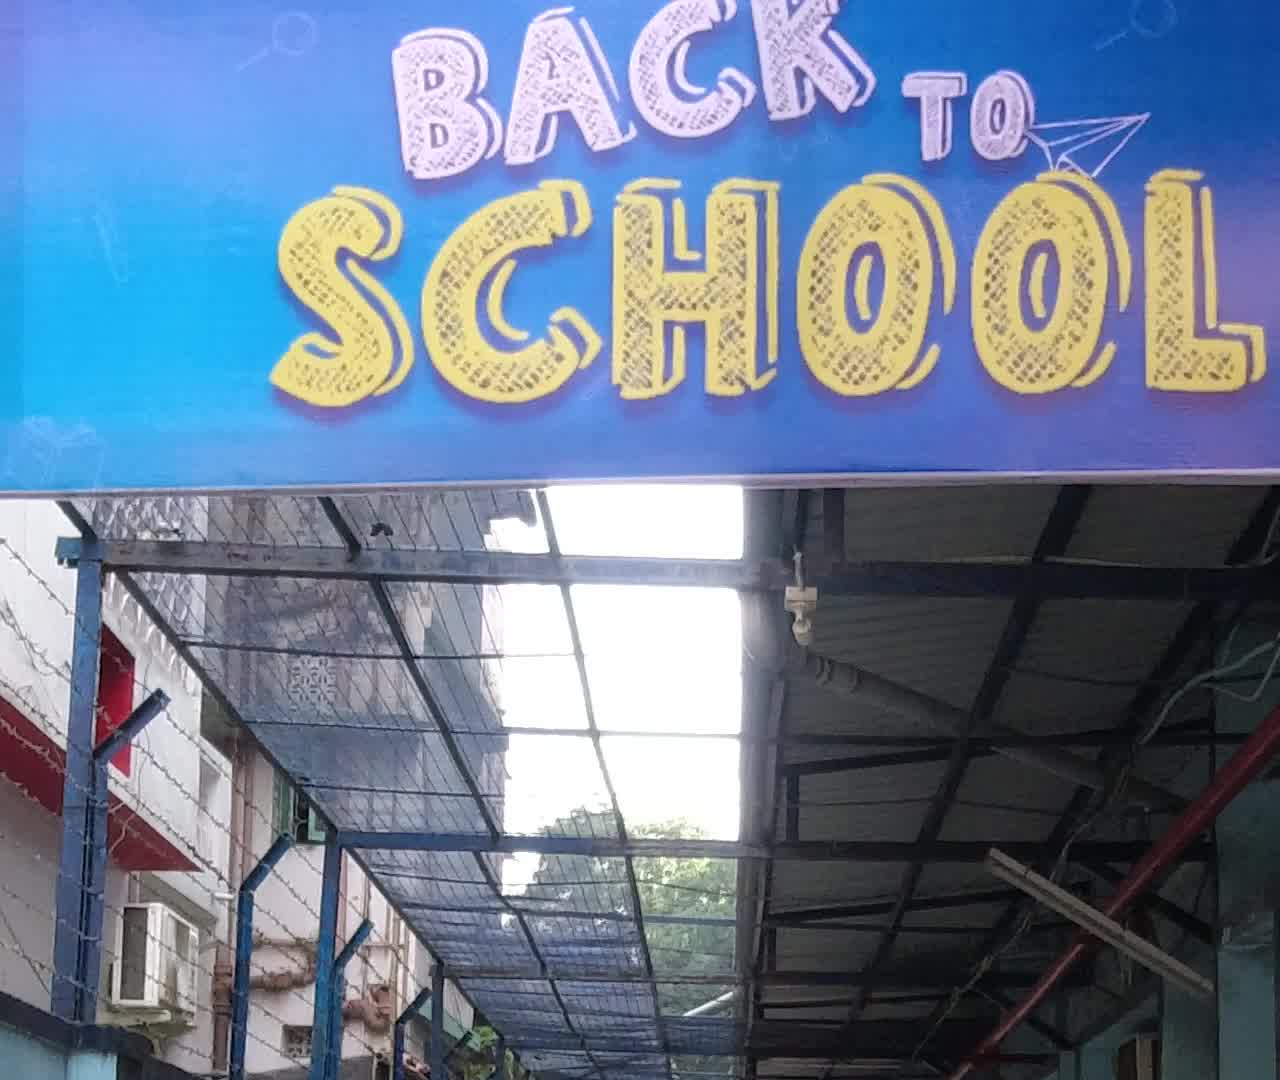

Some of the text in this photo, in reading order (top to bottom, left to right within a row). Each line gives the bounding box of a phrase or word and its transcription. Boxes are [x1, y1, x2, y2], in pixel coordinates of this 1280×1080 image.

[392, 0, 1036, 179] BACK TO
[269, 168, 1266, 407] SCHOOL
